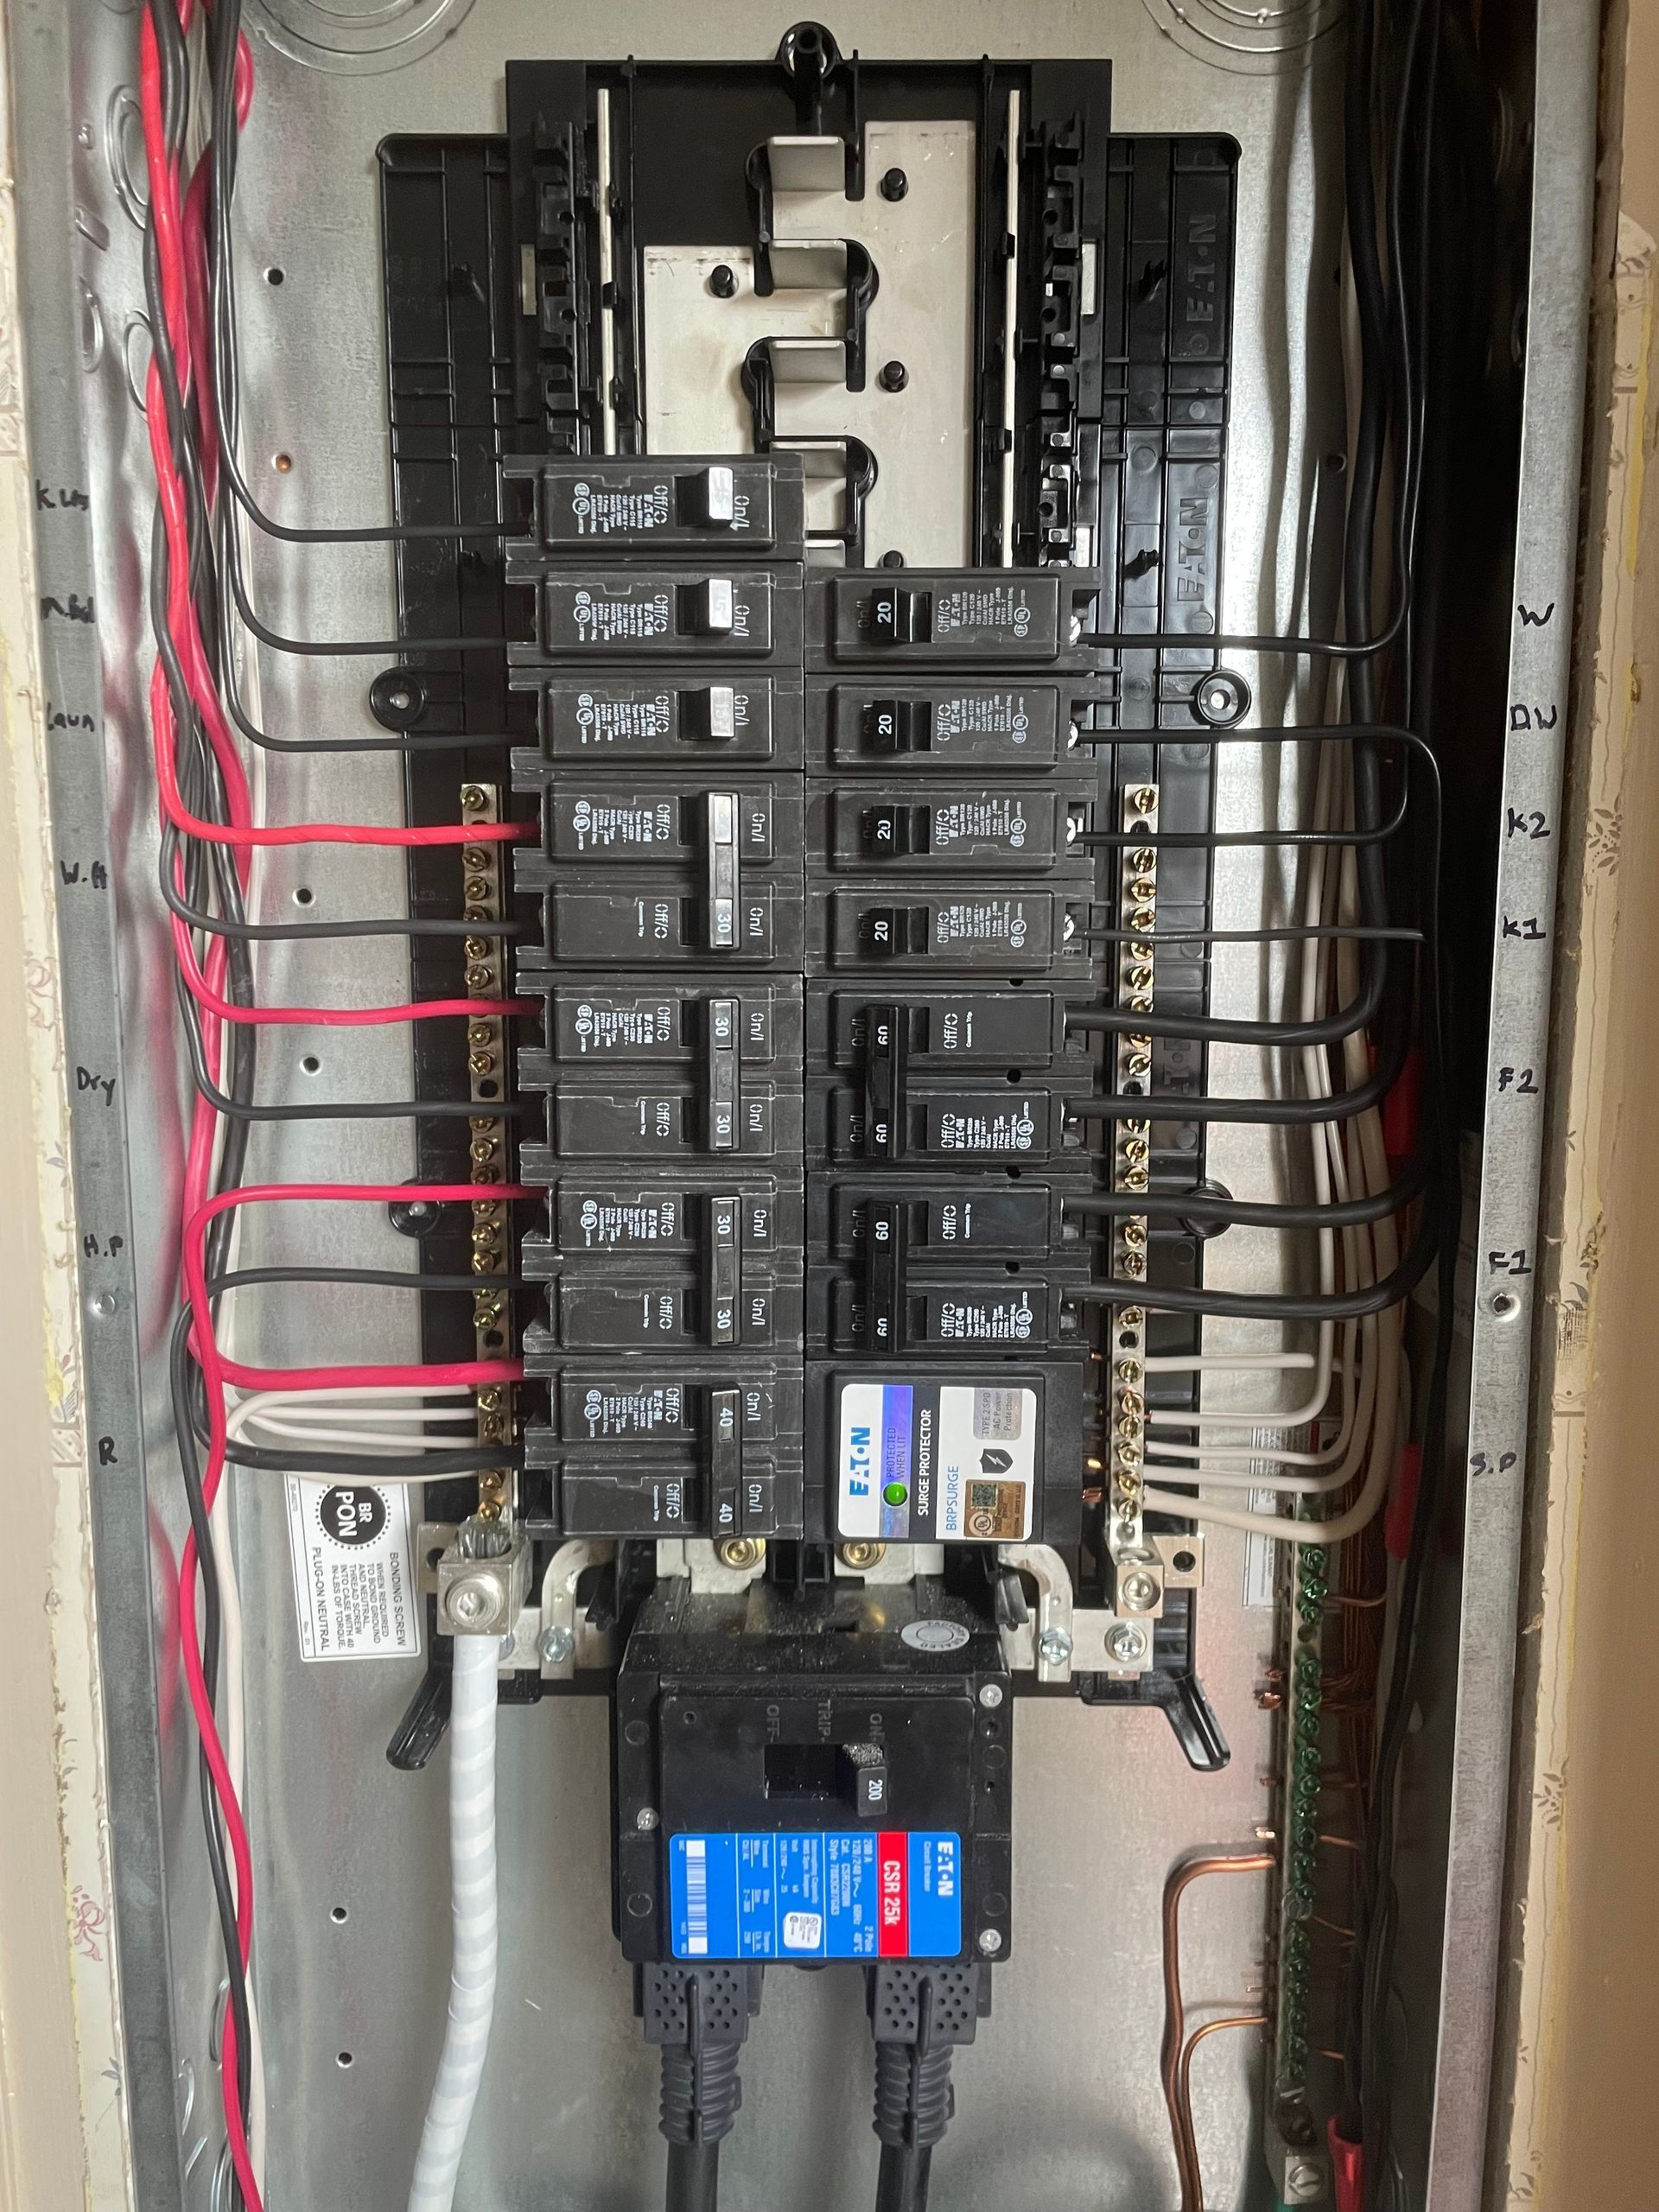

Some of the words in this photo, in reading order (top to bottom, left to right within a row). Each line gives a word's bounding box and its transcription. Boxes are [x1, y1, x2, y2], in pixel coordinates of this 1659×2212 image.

[1178, 497, 1208, 601] EATON
[878, 602, 891, 623] 20
[1517, 603, 1554, 626] W
[879, 715, 892, 734] 20
[878, 820, 891, 840] 20
[1508, 808, 1550, 840] K2
[717, 913, 731, 932] 30
[875, 921, 888, 941] 20
[1503, 916, 1547, 940] K1
[715, 1018, 728, 1036] 30
[76, 1066, 116, 1106] Dry
[1498, 1067, 1539, 1093] F2
[717, 1115, 729, 1134] 30
[717, 1215, 730, 1234] 30
[876, 1222, 888, 1240] 60
[84, 1235, 124, 1256] H.P
[1488, 1249, 1531, 1274] F1
[717, 1310, 730, 1329] 30
[720, 1408, 733, 1427] 40
[994, 1418, 1001, 1429] AC
[1004, 1393, 1013, 1431] Protection
[99, 1437, 117, 1465] R
[887, 1428, 896, 1478] PROTECTED
[897, 1436, 906, 1448] LIT
[919, 1410, 931, 1476] PROTECTOR
[849, 1427, 870, 1496] EATON
[897, 1450, 906, 1478] WHEN
[918, 1479, 930, 1516] SURGE
[946, 1466, 958, 1530] BRPSURGE
[336, 1491, 357, 1536] PON
[359, 1503, 372, 1522] BR
[719, 1503, 732, 1522] 40
[313, 1548, 325, 1597] PLUG-ON
[332, 1565, 340, 1593] IN-LBS
[350, 1564, 359, 1599] THREAD
[367, 1563, 374, 1575] TO
[390, 1553, 402, 1603] BONDING
[334, 1597, 341, 1608] OF
[342, 1588, 351, 1611] CASE
[368, 1578, 377, 1603] BOND
[317, 1600, 329, 1651] NEUTRAL
[353, 1603, 362, 1635] SCREW
[371, 1605, 380, 1643] GROUND
[379, 1592, 389, 1637] REQUIRED
[394, 1606, 406, 1646] SCREW
[868, 1779, 883, 1801] 200
[829, 1840, 839, 1860] Style
[884, 1860, 900, 1893] CSR
[938, 1841, 953, 1896] EATON
[884, 1897, 900, 1925] 25k
[864, 1933, 873, 1952] Pole
